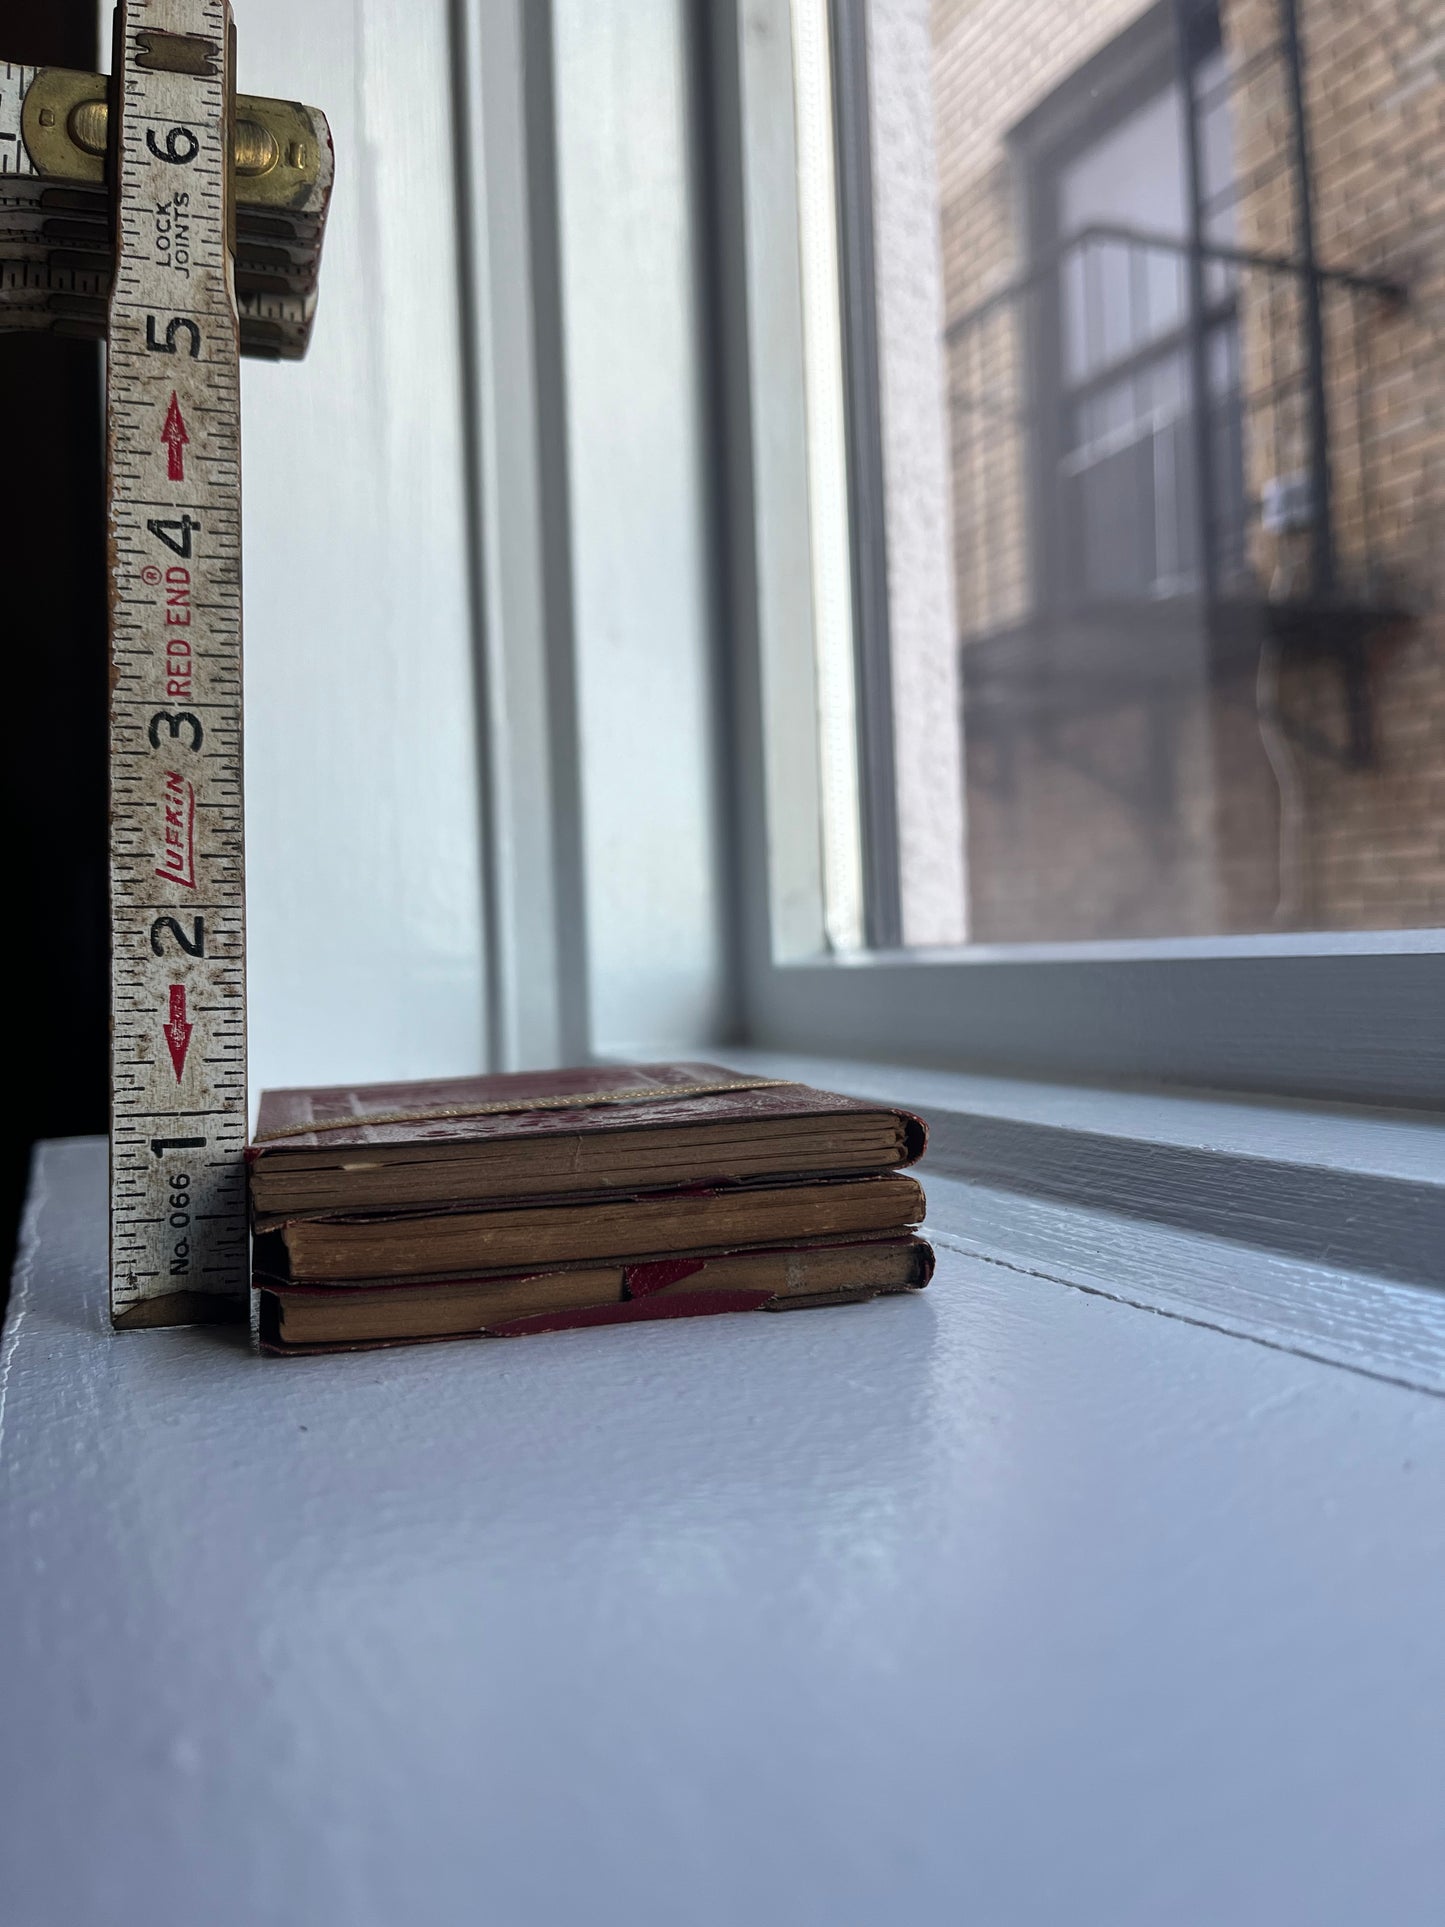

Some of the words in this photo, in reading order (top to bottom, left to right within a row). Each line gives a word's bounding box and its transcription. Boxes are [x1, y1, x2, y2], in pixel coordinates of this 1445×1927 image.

[146, 126, 200, 166] 6
[155, 200, 172, 268] LOCK
[174, 191, 190, 280] JOINTS
[146, 314, 201, 359] 5
[147, 514, 201, 559] 4
[165, 565, 192, 626] END
[166, 637, 192, 698] RED
[148, 711, 204, 752] 3
[150, 915, 205, 957] 2
[150, 1136, 207, 1159] 1
[168, 1173, 191, 1229] 066
